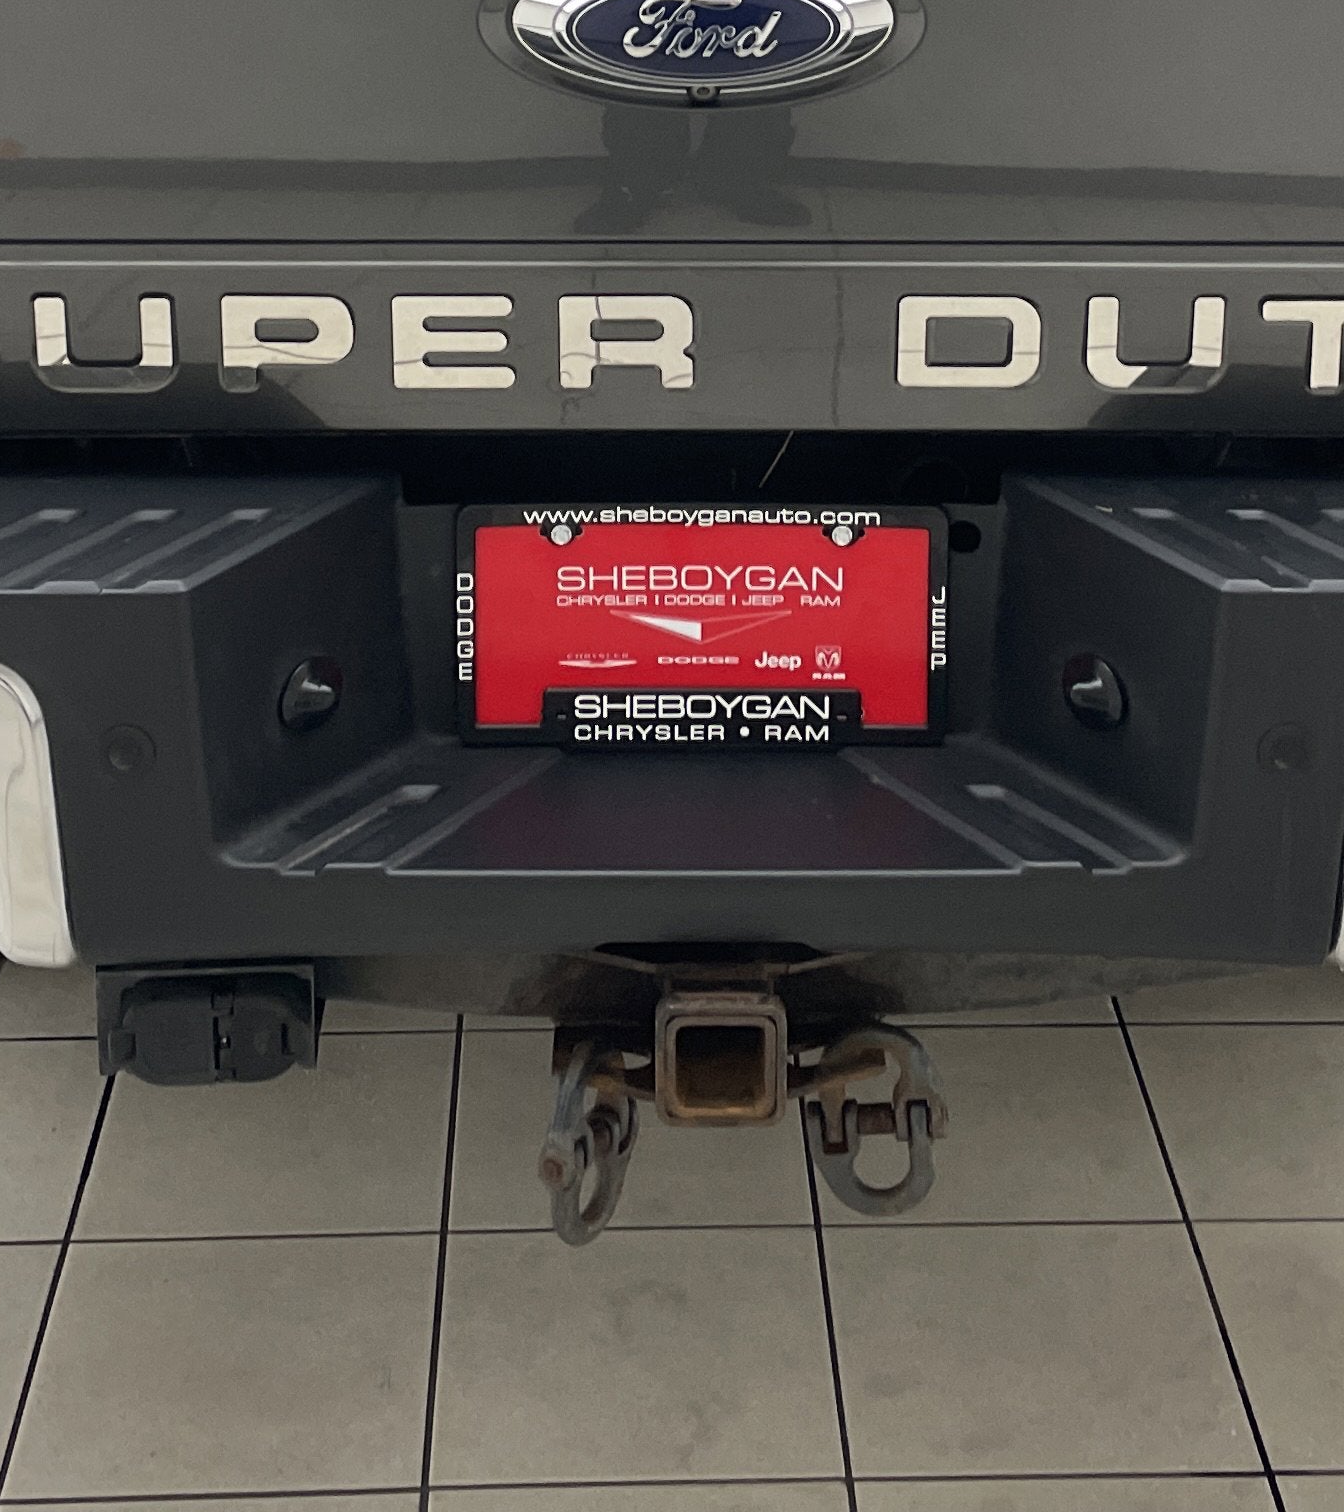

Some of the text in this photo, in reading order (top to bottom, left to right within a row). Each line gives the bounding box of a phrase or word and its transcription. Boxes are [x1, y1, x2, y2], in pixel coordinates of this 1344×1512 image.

[523, 506, 881, 527] www.sheboyganauto.com
[556, 565, 844, 592] SHEBOYGAN
[556, 594, 841, 607] CHRYSLER DODGE JEEP RAM
[456, 573, 474, 682] DODGE
[931, 586, 947, 671] JEEP
[657, 656, 740, 665] DODGE
[754, 651, 802, 671] Jeep
[574, 694, 830, 720] SHEBOYGAN
[574, 724, 830, 742] CHRYSLER RAM
